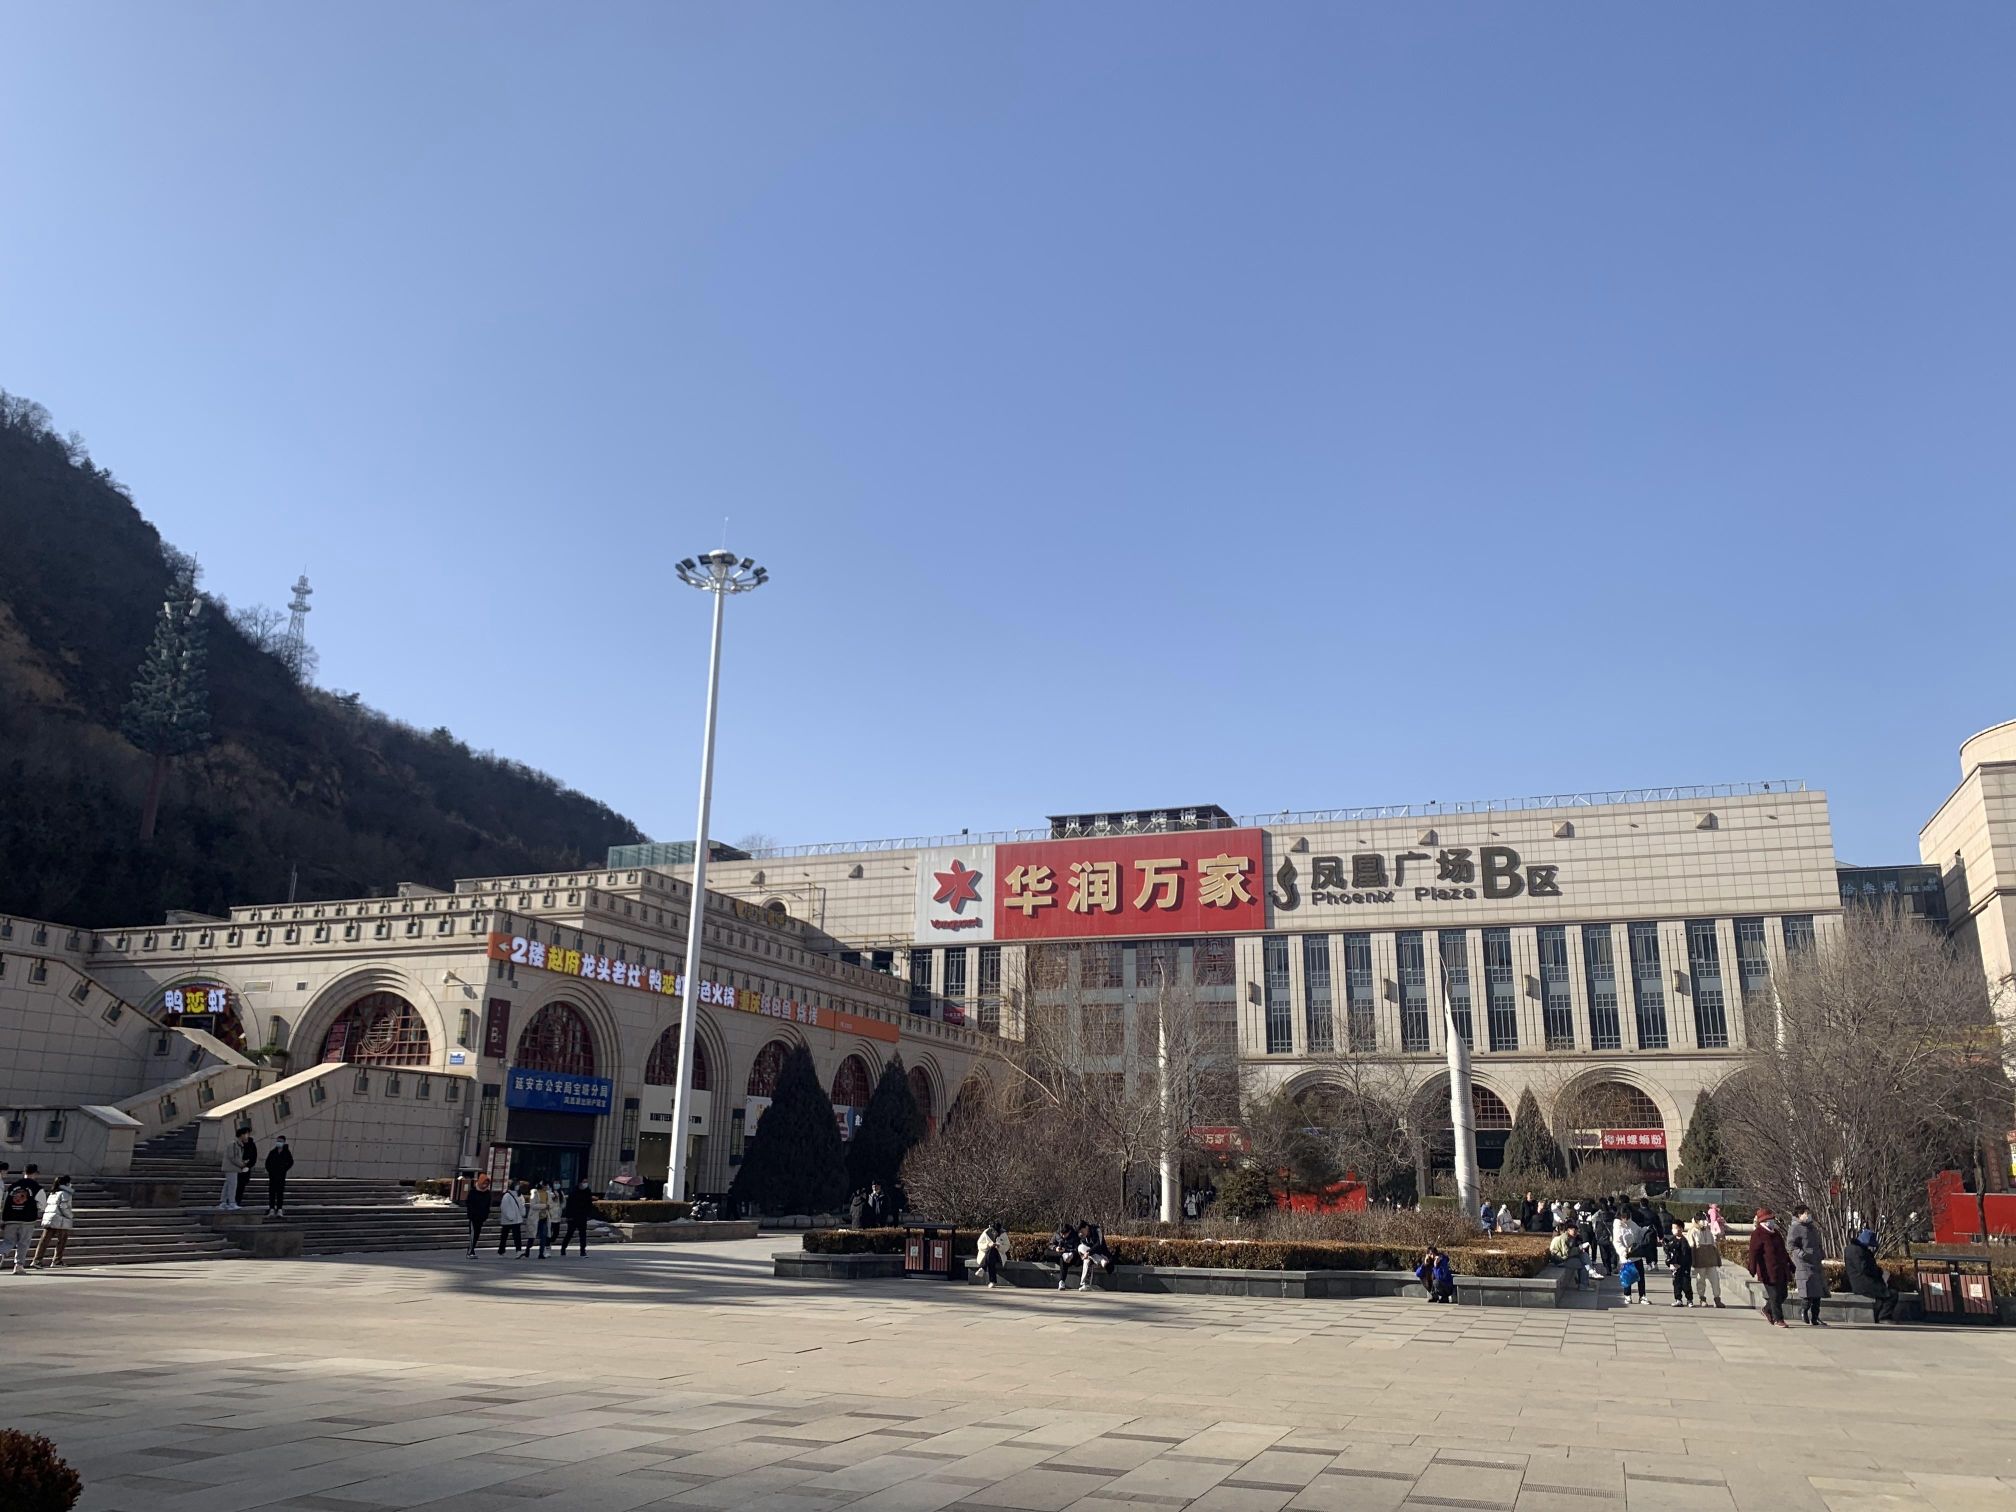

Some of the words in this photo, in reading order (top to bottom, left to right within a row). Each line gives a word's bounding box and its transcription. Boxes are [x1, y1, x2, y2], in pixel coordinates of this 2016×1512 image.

[1004, 853, 1252, 916] 华润万家
[1310, 848, 1476, 890] 凤凰广场
[1480, 846, 1563, 900] B区
[1311, 890, 1396, 906] Phoenix
[1414, 886, 1477, 902] Plaza
[510, 936, 546, 969] 2楼
[165, 989, 227, 1014] 鸭恋虾
[515, 1076, 609, 1098] 延安市公安局宝塔分局
[1603, 1133, 1662, 1146] 柳州螺蛳粉
